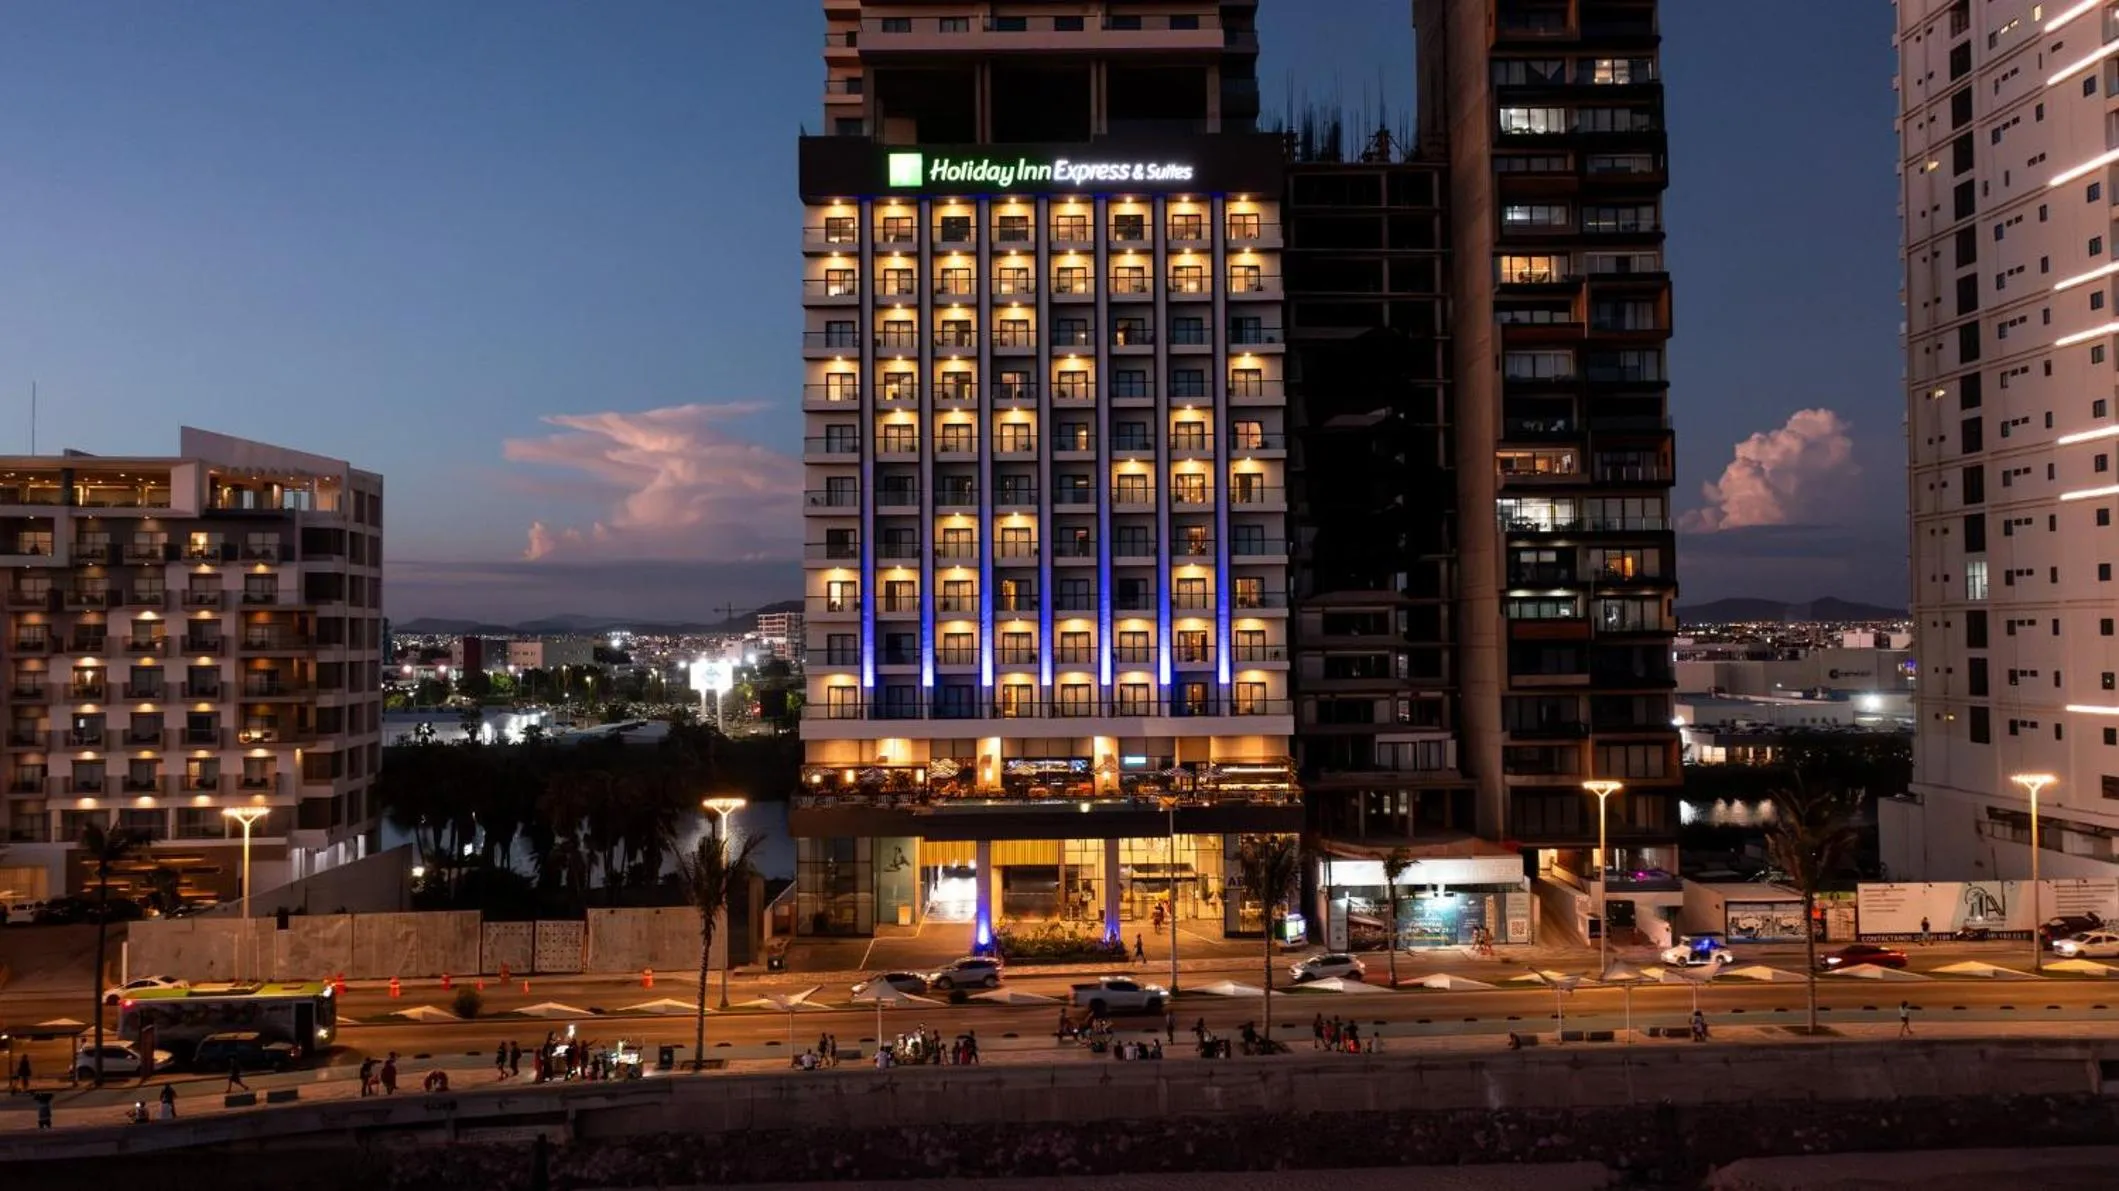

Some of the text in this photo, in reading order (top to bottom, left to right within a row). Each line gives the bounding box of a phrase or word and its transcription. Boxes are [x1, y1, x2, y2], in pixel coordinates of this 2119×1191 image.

[930, 158, 1194, 187] Holiday Inn Express & Suites
